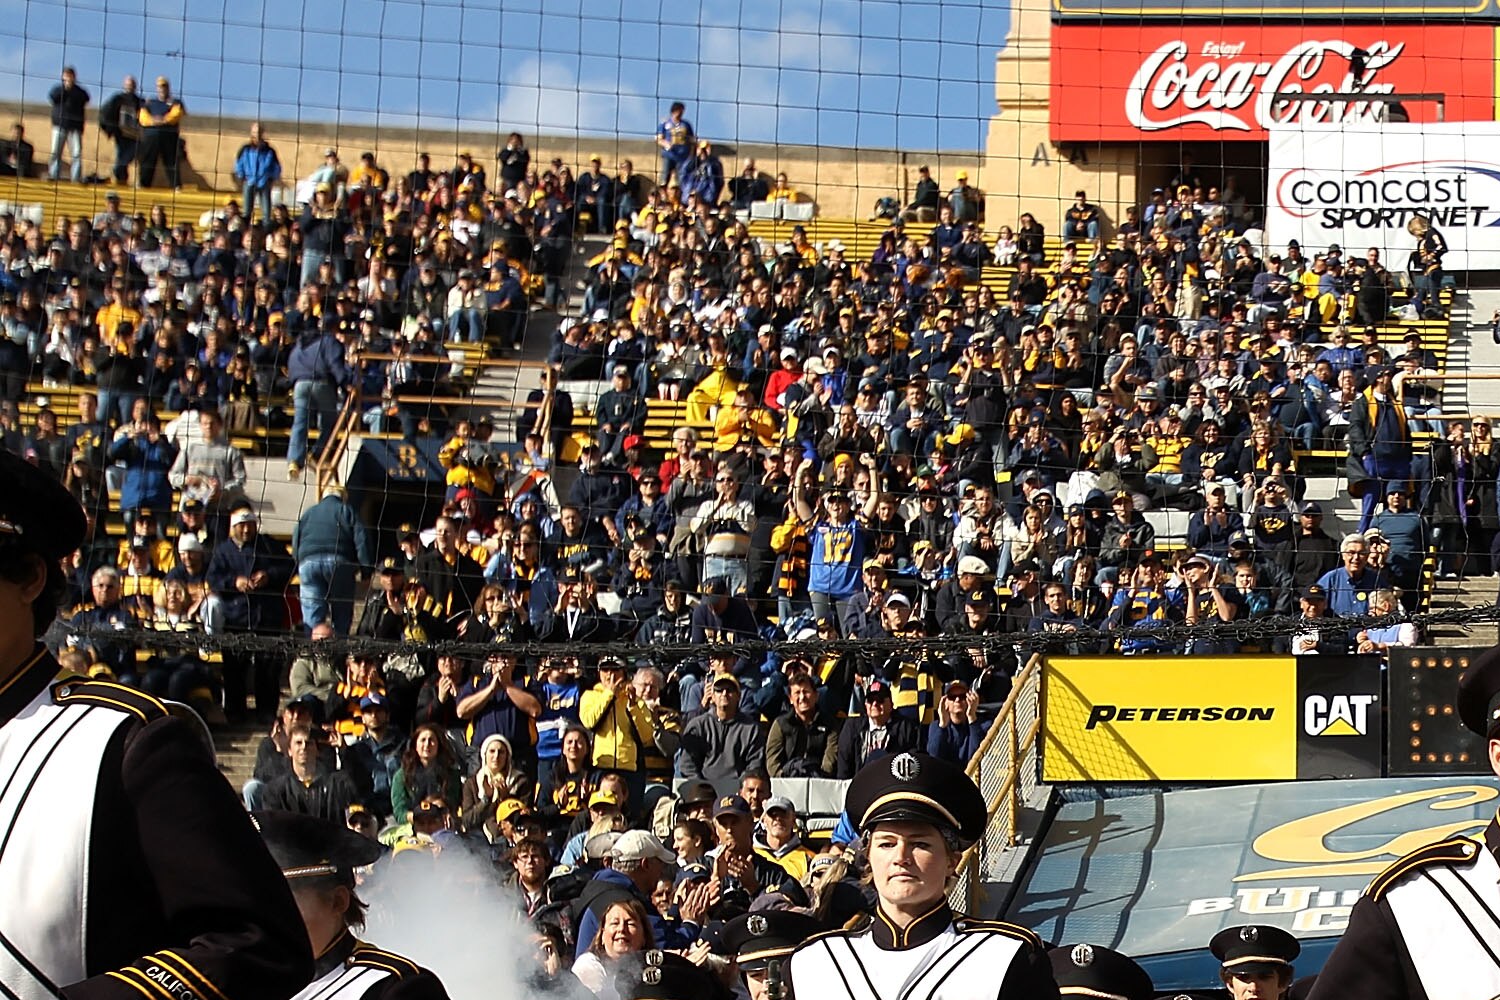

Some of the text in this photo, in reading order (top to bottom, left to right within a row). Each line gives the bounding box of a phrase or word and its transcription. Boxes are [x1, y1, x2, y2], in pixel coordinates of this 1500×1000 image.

[1125, 40, 1404, 131] Coca-Cola
[1292, 175, 1467, 205] comcast
[1085, 705, 1275, 730] PETERSON
[1304, 695, 1372, 736] CAT
